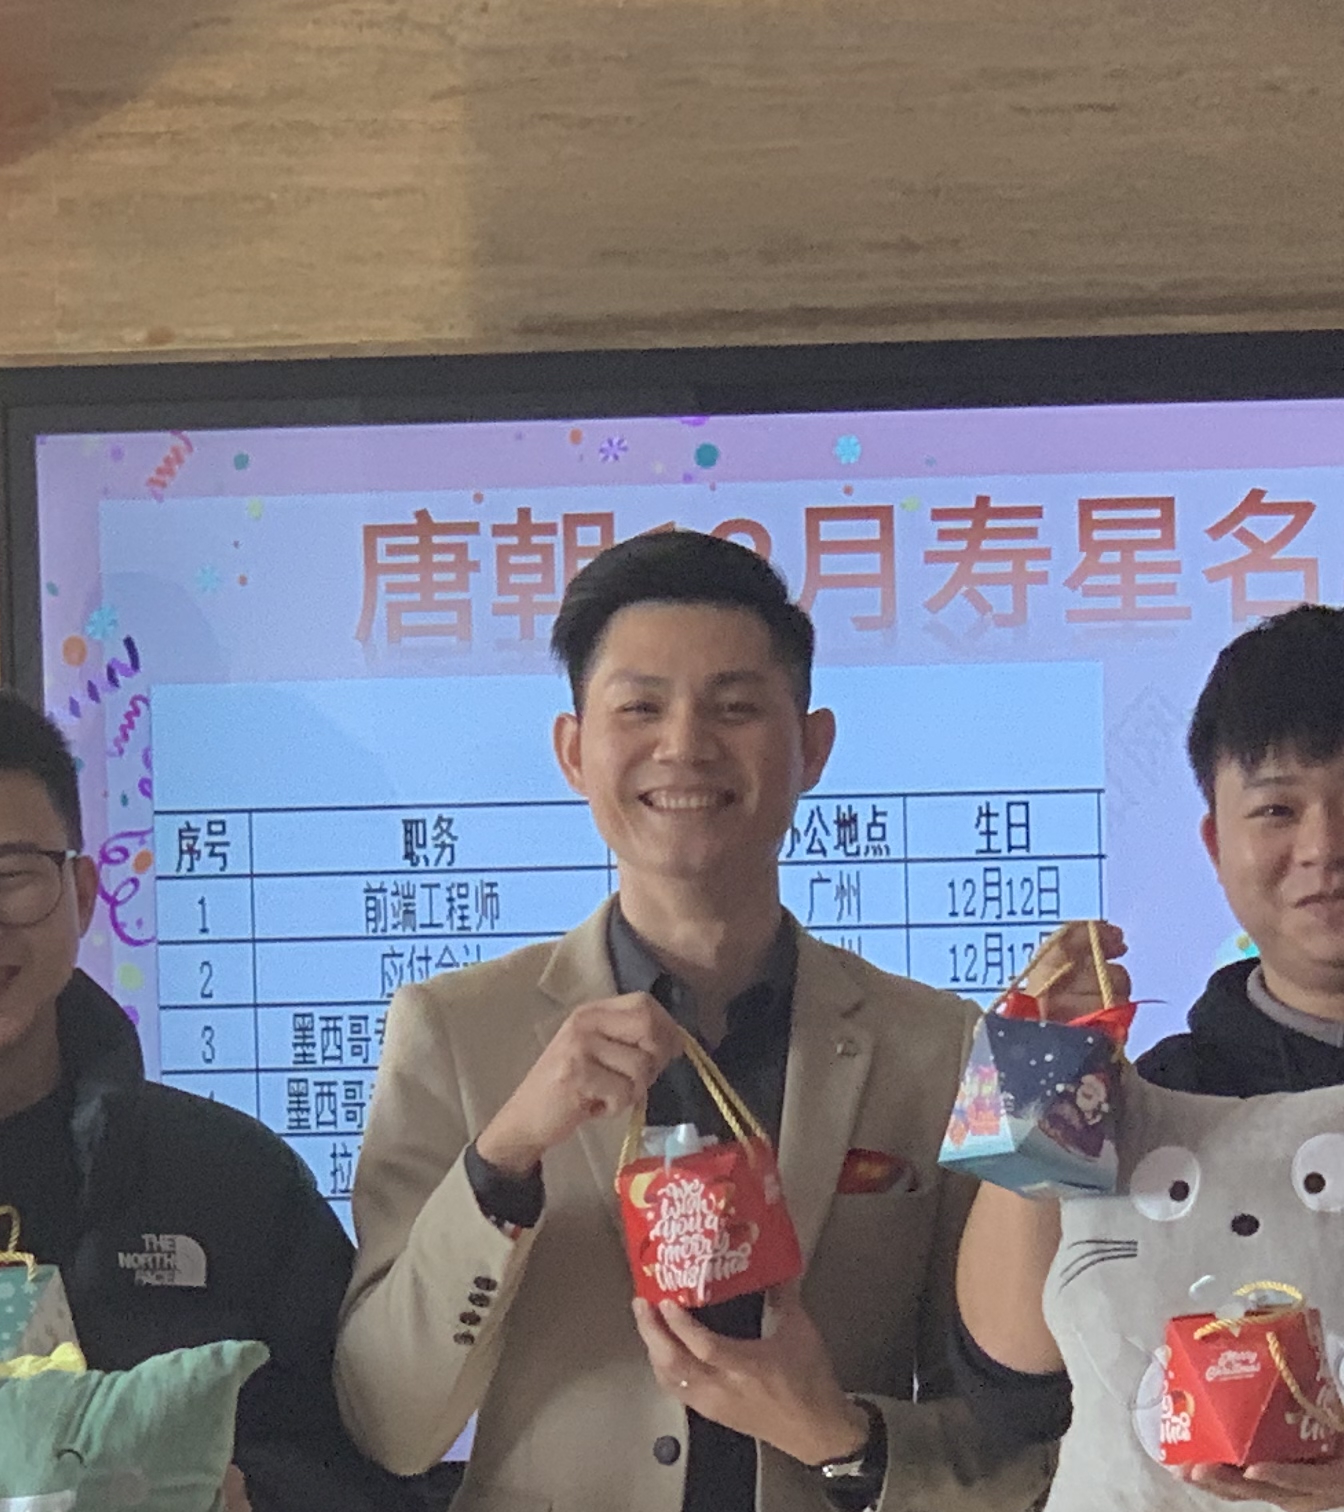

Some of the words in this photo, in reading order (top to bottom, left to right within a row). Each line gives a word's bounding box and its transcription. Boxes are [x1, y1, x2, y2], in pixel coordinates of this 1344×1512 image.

[176, 819, 230, 872] 序号
[402, 814, 458, 867] 职务
[975, 800, 1030, 854] 生日
[198, 896, 209, 934] 1
[363, 880, 500, 933] 前端工程师
[808, 870, 862, 922] 广州
[948, 866, 1060, 919] 12月12日
[199, 961, 214, 999] 2
[200, 1025, 216, 1064] 3
[287, 1078, 374, 1130] 墨西哥
[118, 1251, 177, 1271] NORTH
[141, 1233, 176, 1253] THE
